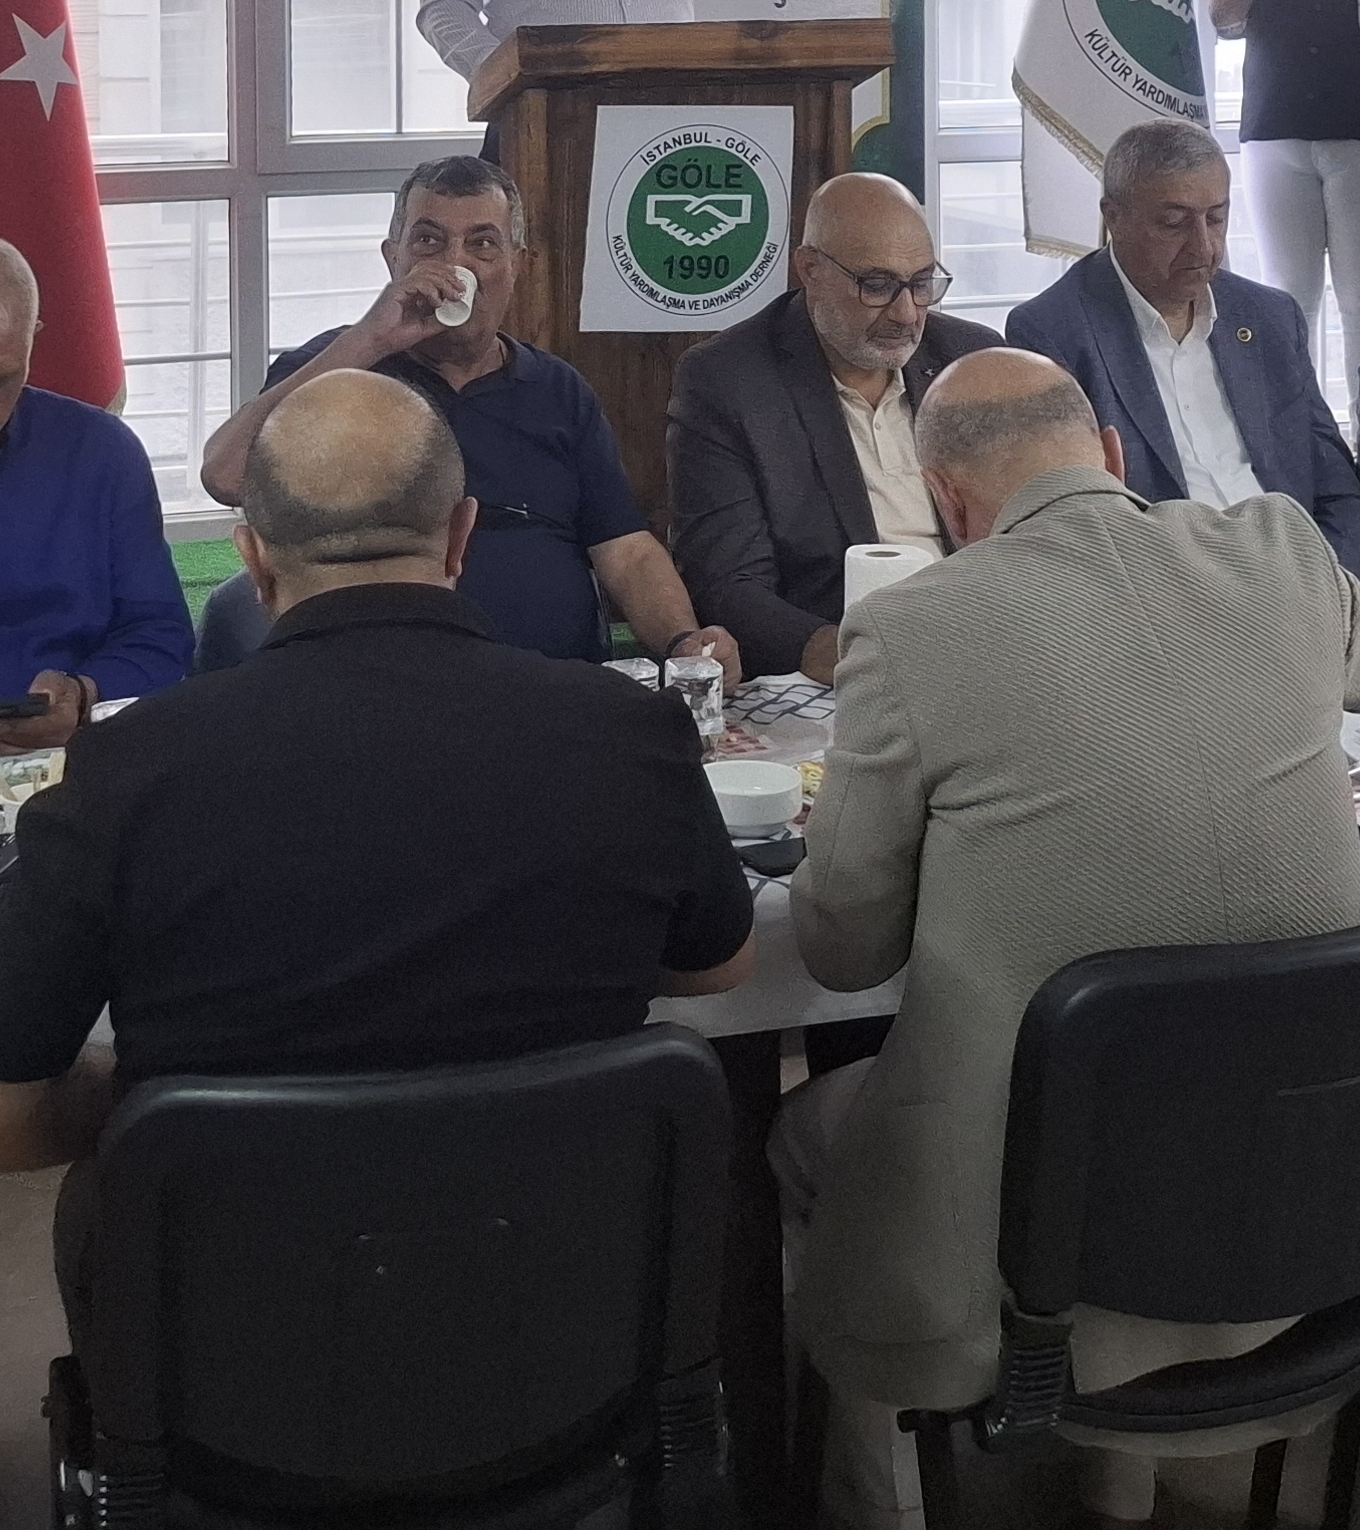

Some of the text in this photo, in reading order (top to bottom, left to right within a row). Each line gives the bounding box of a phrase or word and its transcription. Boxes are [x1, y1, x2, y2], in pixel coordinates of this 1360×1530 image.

[1084, 28, 1133, 83] KÜLTÜR
[640, 131, 713, 166] İSTANBUL
[725, 136, 762, 167] GÖLE
[655, 157, 743, 189] GÖLE
[612, 234, 779, 311] KÜLTÜR YARDIMLAŞMA VE DAYANIŞMA DERNEĞİ
[663, 254, 730, 280] 1990
